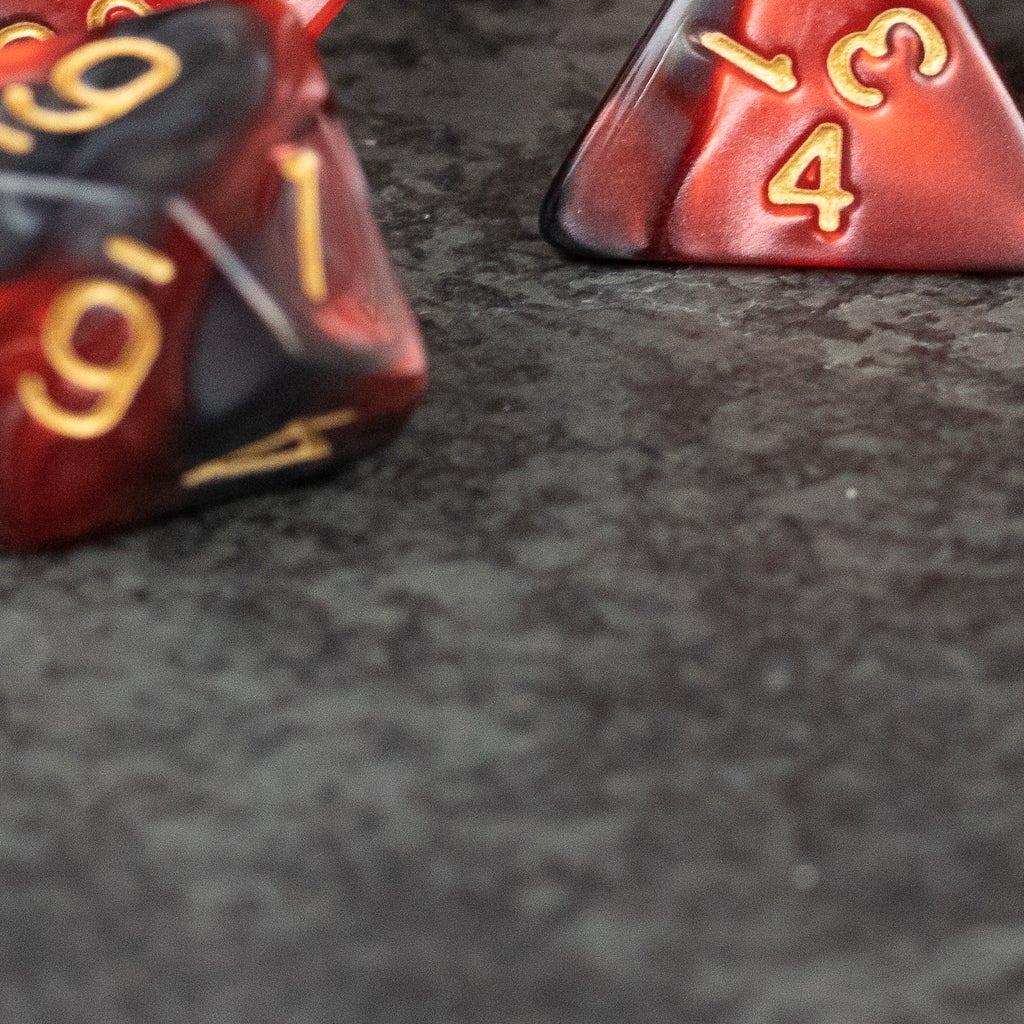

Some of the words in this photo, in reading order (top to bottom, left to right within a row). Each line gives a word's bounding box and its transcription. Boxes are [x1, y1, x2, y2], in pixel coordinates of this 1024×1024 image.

[700, 31, 798, 92] 1
[826, 7, 948, 107] 3
[278, 149, 326, 302] 1
[767, 122, 855, 232] 4
